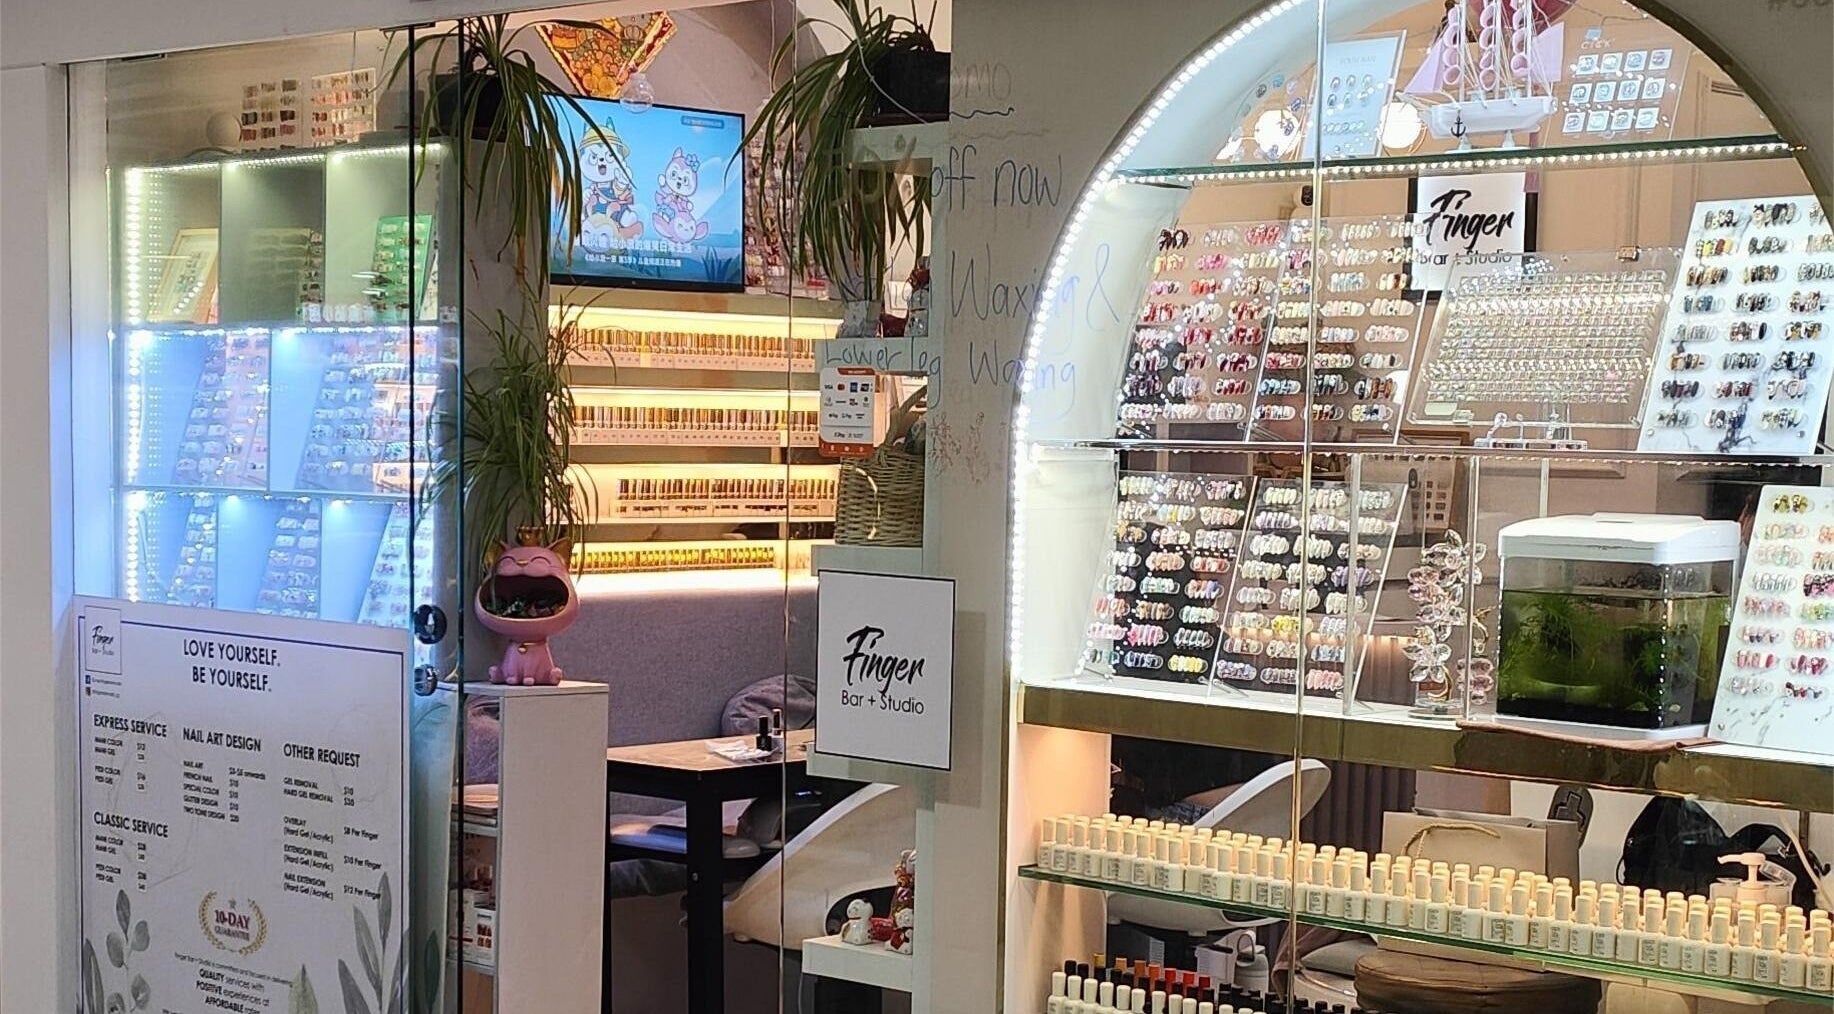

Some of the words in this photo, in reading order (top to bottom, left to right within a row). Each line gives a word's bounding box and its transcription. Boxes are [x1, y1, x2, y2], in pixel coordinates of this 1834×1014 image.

[930, 145, 976, 209] off
[994, 155, 1062, 207] now
[1423, 189, 1514, 250] Finger
[1464, 249, 1513, 265] Studio
[824, 324, 902, 371] Lower
[911, 336, 941, 410] leg
[184, 639, 214, 658] LOVE
[218, 643, 281, 667] YOURSELF.
[843, 625, 925, 696] Finger
[192, 666, 206, 683] BE
[210, 668, 272, 692] YOURSELF.
[841, 690, 864, 707] Bar
[868, 696, 876, 706] +
[880, 692, 925, 715] Studio
[94, 714, 129, 731] EXPRESS
[131, 720, 167, 737] SERVICE
[183, 727, 204, 743] NAIL
[207, 732, 223, 745] ART
[226, 734, 261, 752] DESIGN
[283, 743, 315, 761] OTHER
[317, 748, 360, 768] REQUEST
[94, 812, 129, 830] CLASSIC
[133, 819, 168, 838] SERVICE
[215, 909, 250, 930] 10-DAY
[196, 980, 222, 995] POSITIVE
[199, 968, 225, 982] QUALITY
[205, 996, 244, 1014] AFFORDABLE
